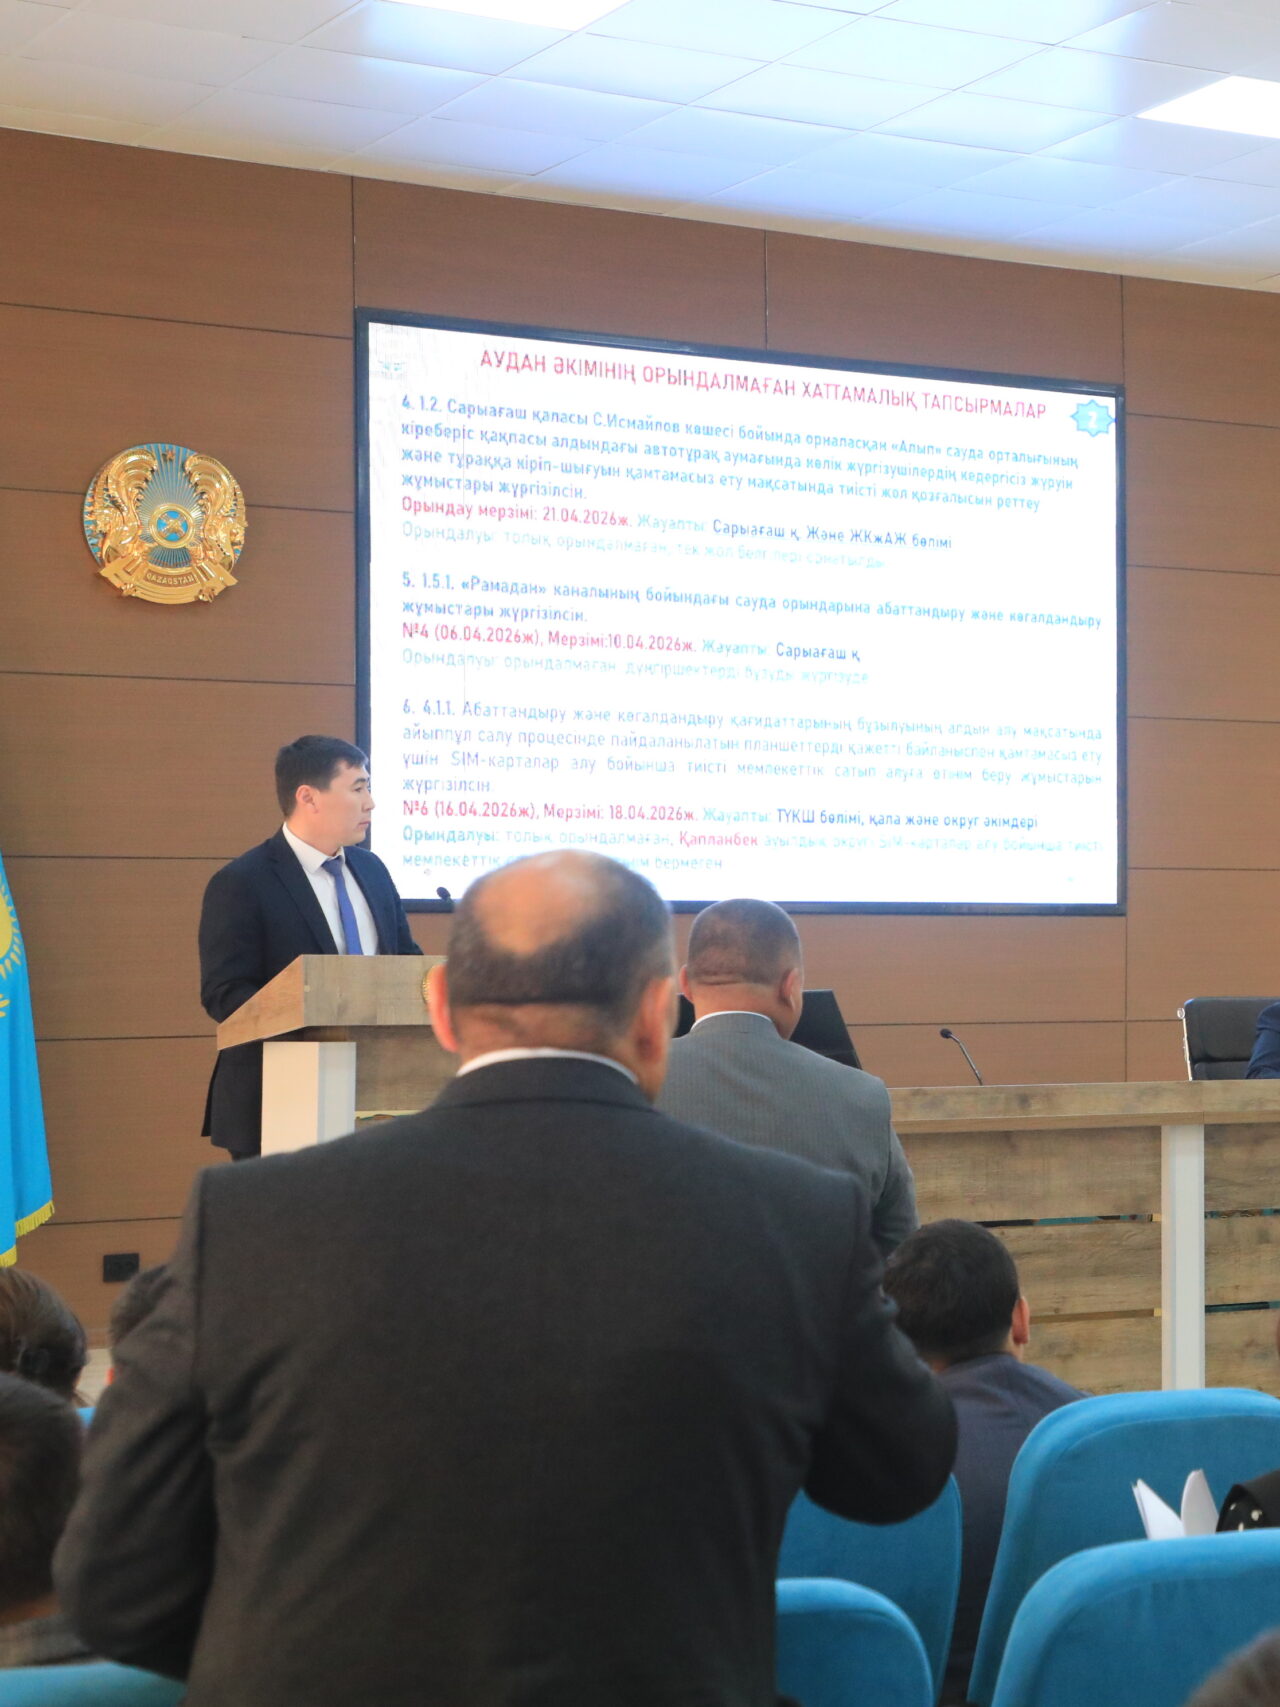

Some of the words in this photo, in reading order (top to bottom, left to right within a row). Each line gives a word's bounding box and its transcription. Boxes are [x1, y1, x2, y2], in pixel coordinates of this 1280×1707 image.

[479, 348, 546, 373] АУДАН
[553, 355, 636, 384] ӘКІМІНІҢ
[642, 364, 795, 396] ОРЫНДАЛМАҒАН
[802, 381, 918, 411] ХАТТАМАЛЫҚ
[921, 391, 1045, 419] ТАПСЫРМАЛАР
[401, 393, 414, 409] 4.
[806, 524, 844, 544] Және
[402, 570, 414, 588] 5.
[422, 572, 454, 590] 1.5.1.
[460, 575, 546, 595] «Рамадан»
[553, 584, 640, 603] каналының
[645, 586, 729, 606] бойындағы
[735, 594, 776, 611] сауда
[782, 597, 870, 615] орындарына
[876, 601, 965, 622] абаттандыру
[970, 609, 1004, 621] және
[1009, 611, 1101, 630] көгалдандыру
[402, 621, 429, 639] №4
[434, 623, 543, 646] (06.04.2026ж),
[775, 641, 847, 661] Сарыағаш
[402, 799, 429, 816] №6
[434, 799, 539, 819] (16.04.2026ж),
[543, 802, 603, 822] Мерзімі:
[609, 804, 697, 821] 18.04.2026ж.
[776, 807, 814, 824] ТҮКШ
[818, 807, 864, 826] бөлімі,
[869, 814, 900, 826] қала
[904, 815, 938, 826] және
[943, 815, 979, 830] округ
[983, 816, 1037, 831] әкімдері
[679, 830, 757, 848] Қапланбек
